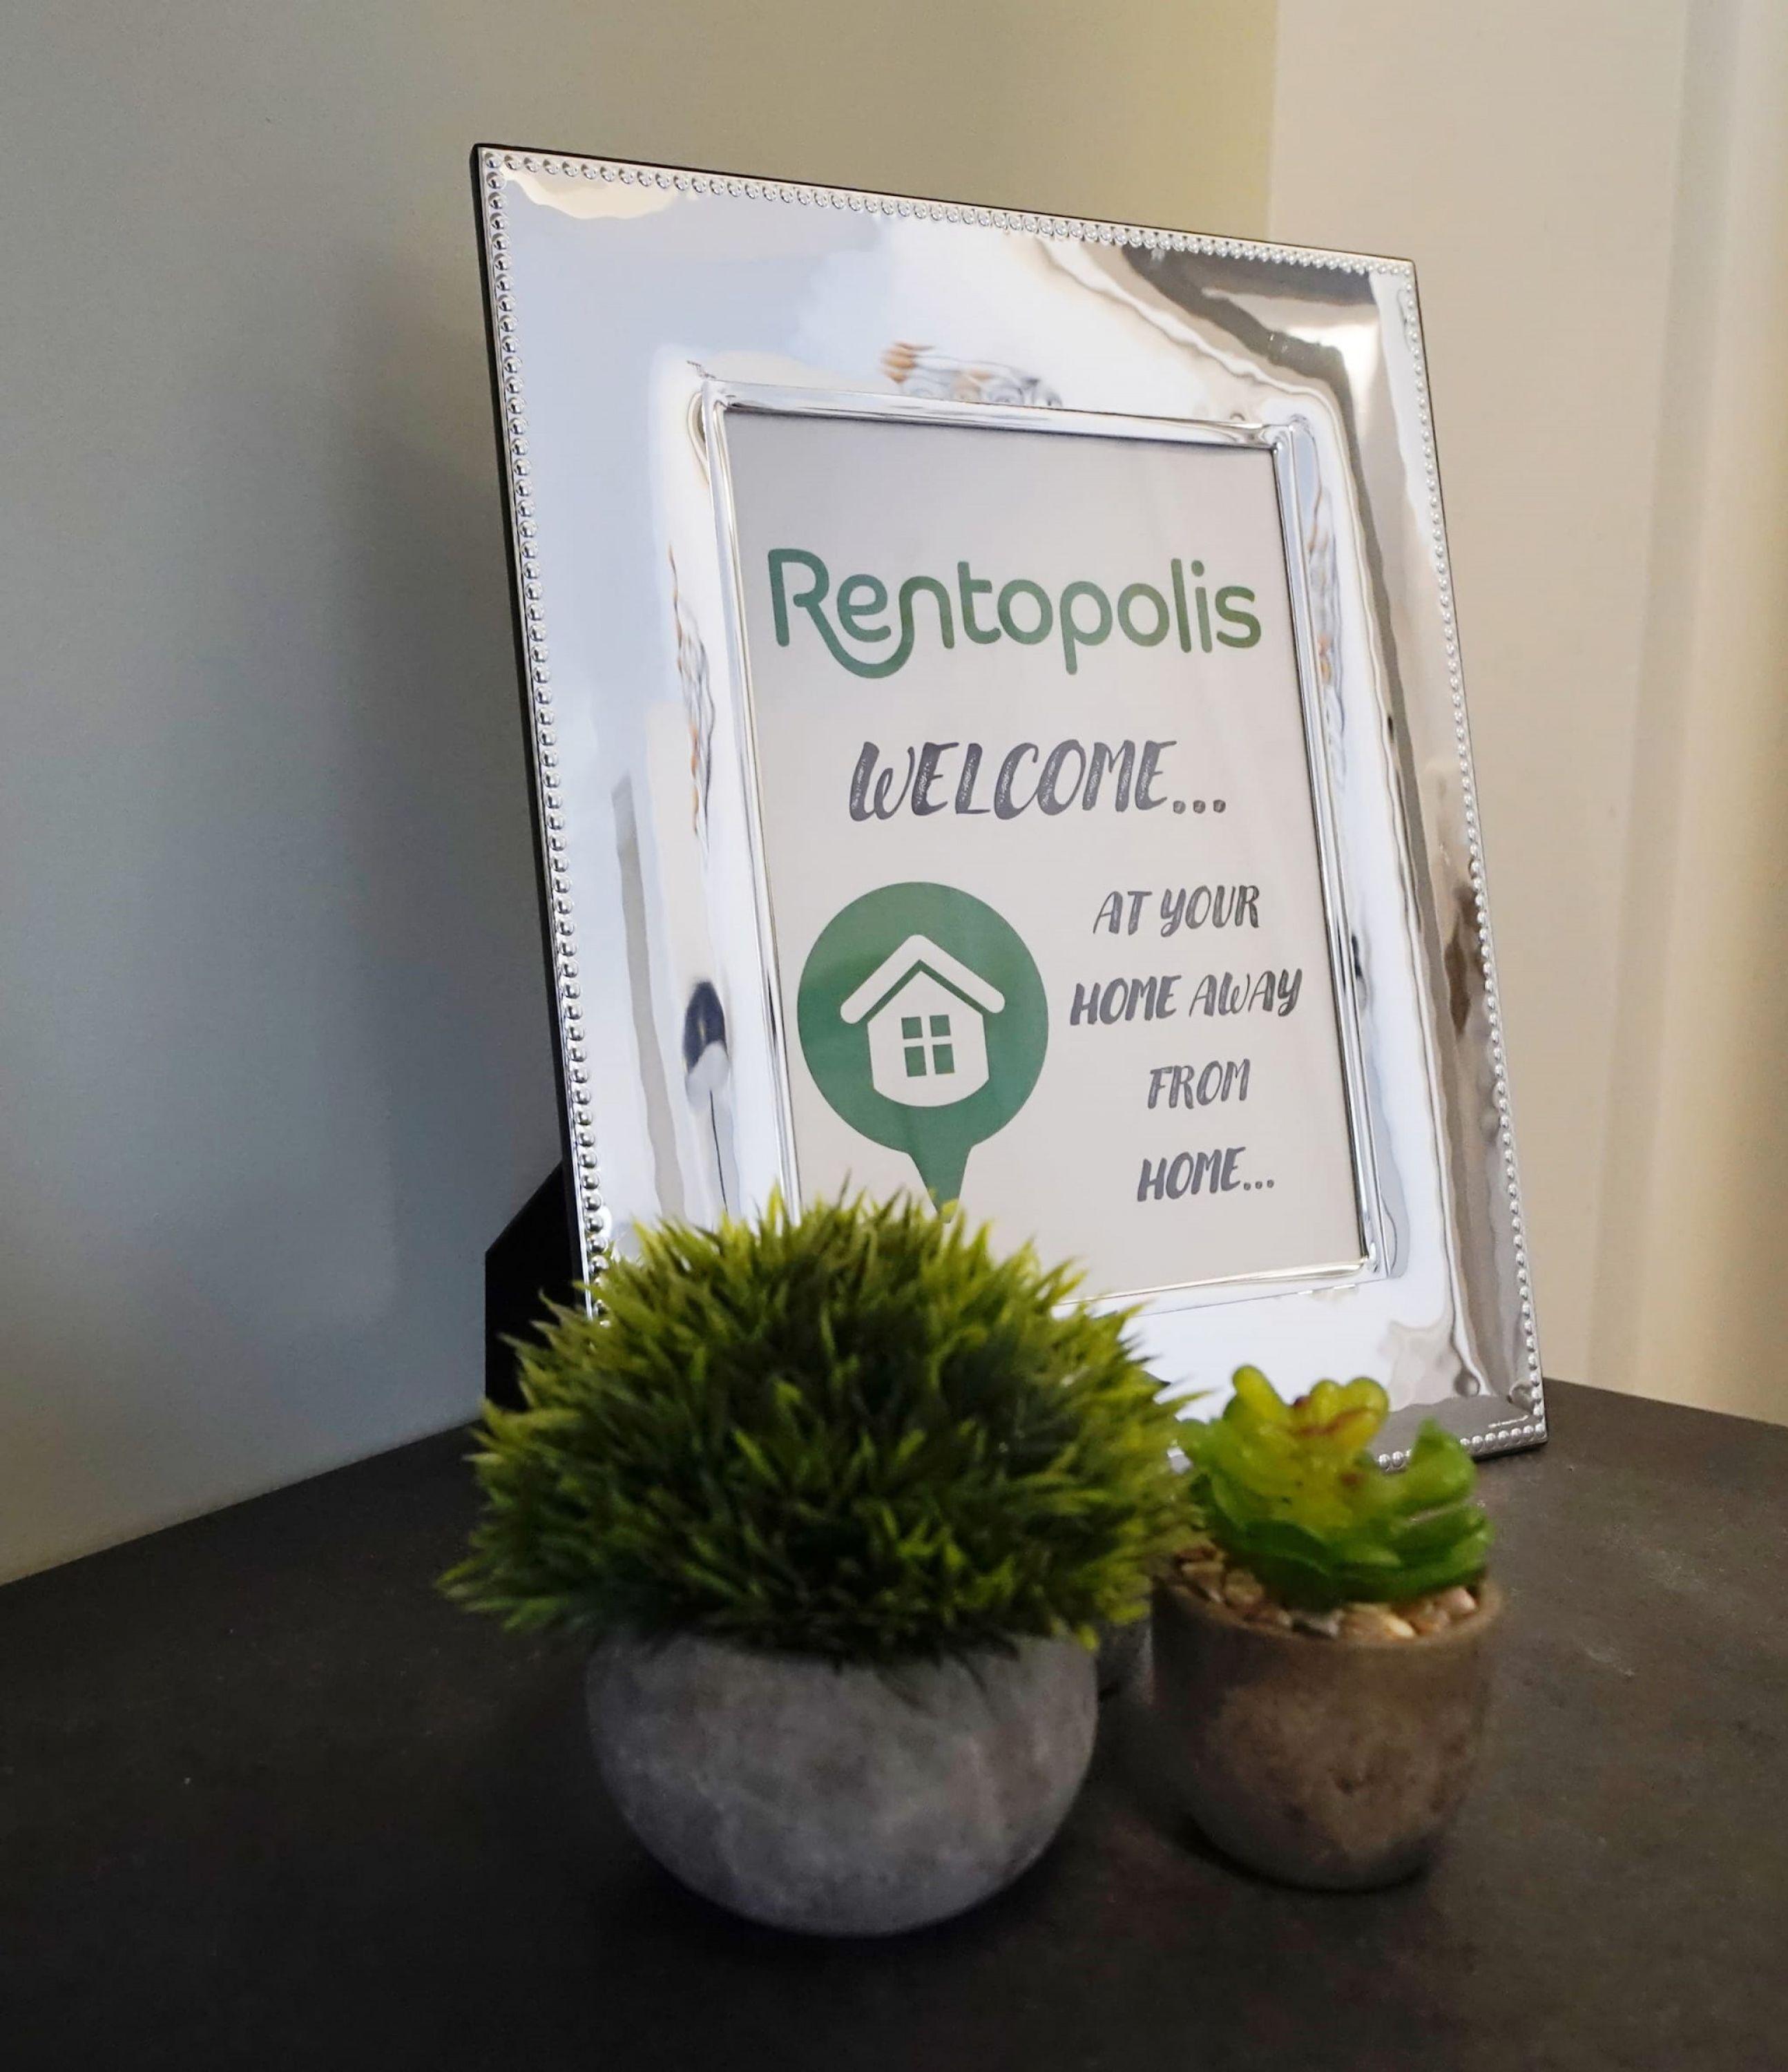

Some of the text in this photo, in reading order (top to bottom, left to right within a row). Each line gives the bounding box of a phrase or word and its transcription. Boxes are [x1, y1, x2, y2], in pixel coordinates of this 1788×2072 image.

[767, 548, 1262, 679] Rentopolis
[849, 739, 1227, 821] WELCOME...
[1093, 885, 1260, 938] AT YOUR
[1069, 968, 1303, 1026] HOME AWAY
[1147, 1058, 1251, 1110] FROM
[1136, 1147, 1275, 1202] HOME...
